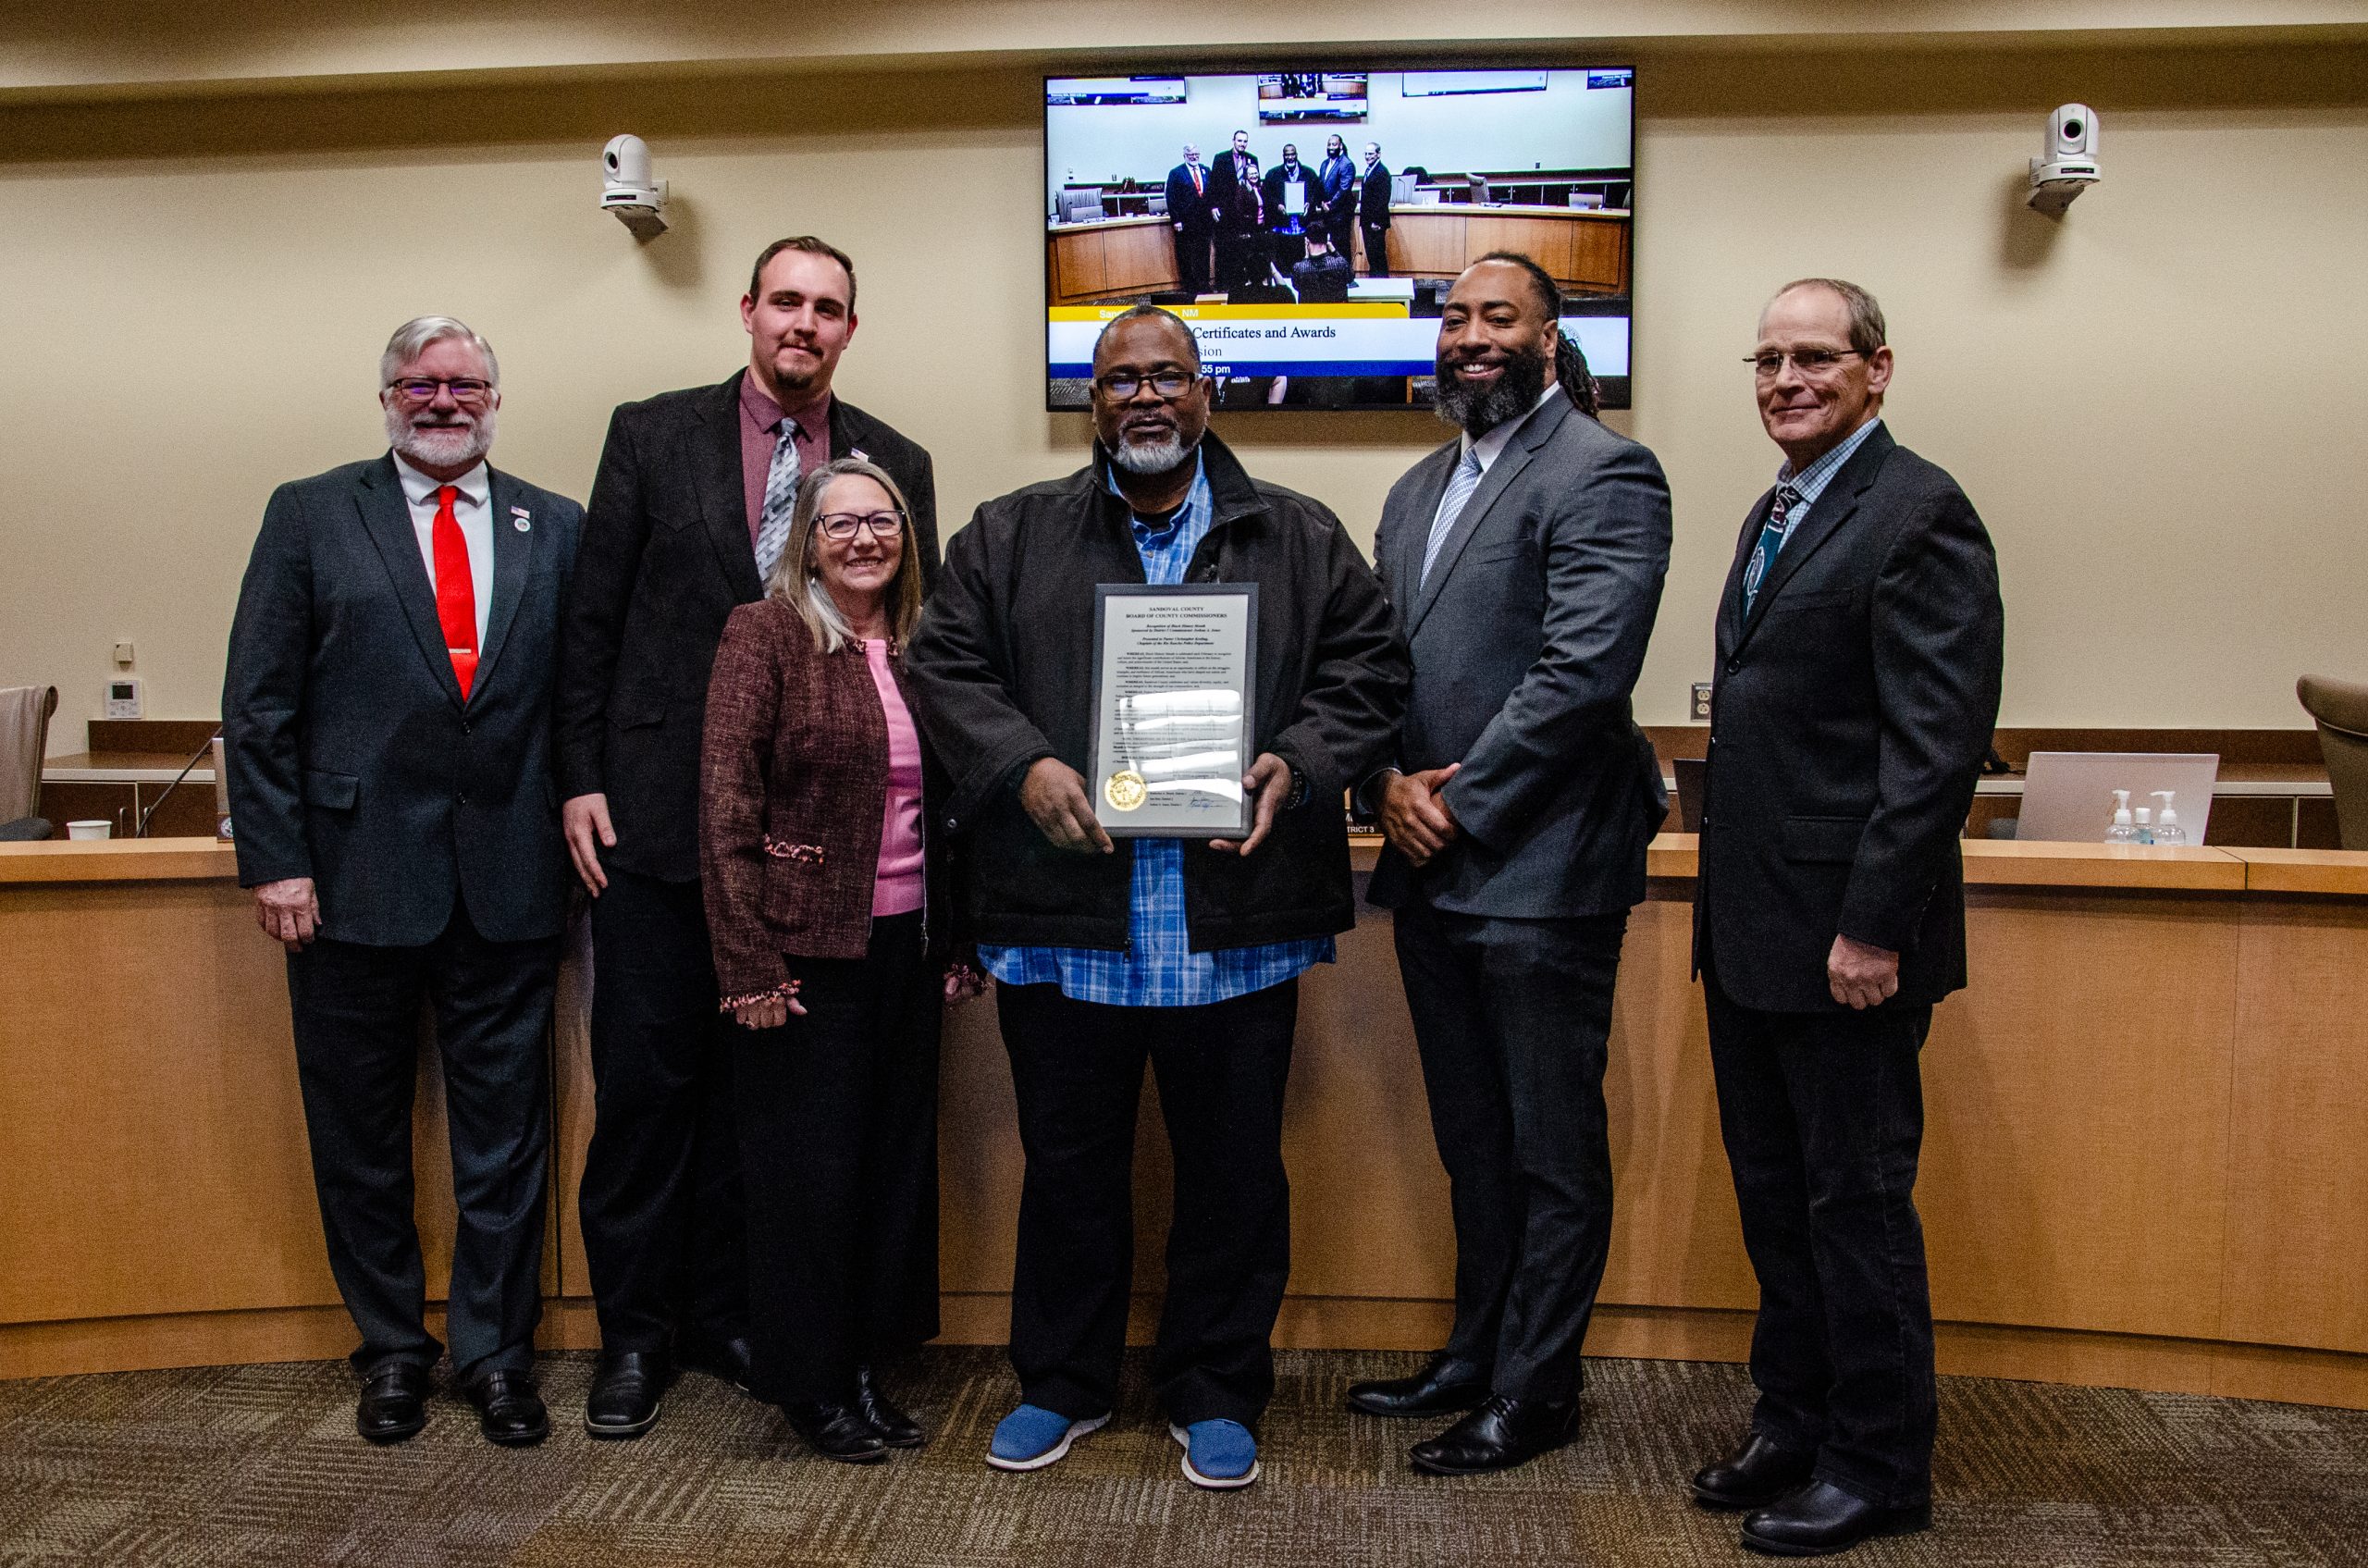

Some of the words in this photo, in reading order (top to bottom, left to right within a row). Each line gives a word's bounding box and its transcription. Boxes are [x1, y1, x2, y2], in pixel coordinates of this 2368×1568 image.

[1182, 309, 1199, 317] NM
[1193, 327, 1261, 340] Certificates
[1264, 327, 1287, 339] and
[1290, 327, 1337, 339] Awards
[1201, 364, 1213, 374] 55
[1215, 365, 1231, 375] pm
